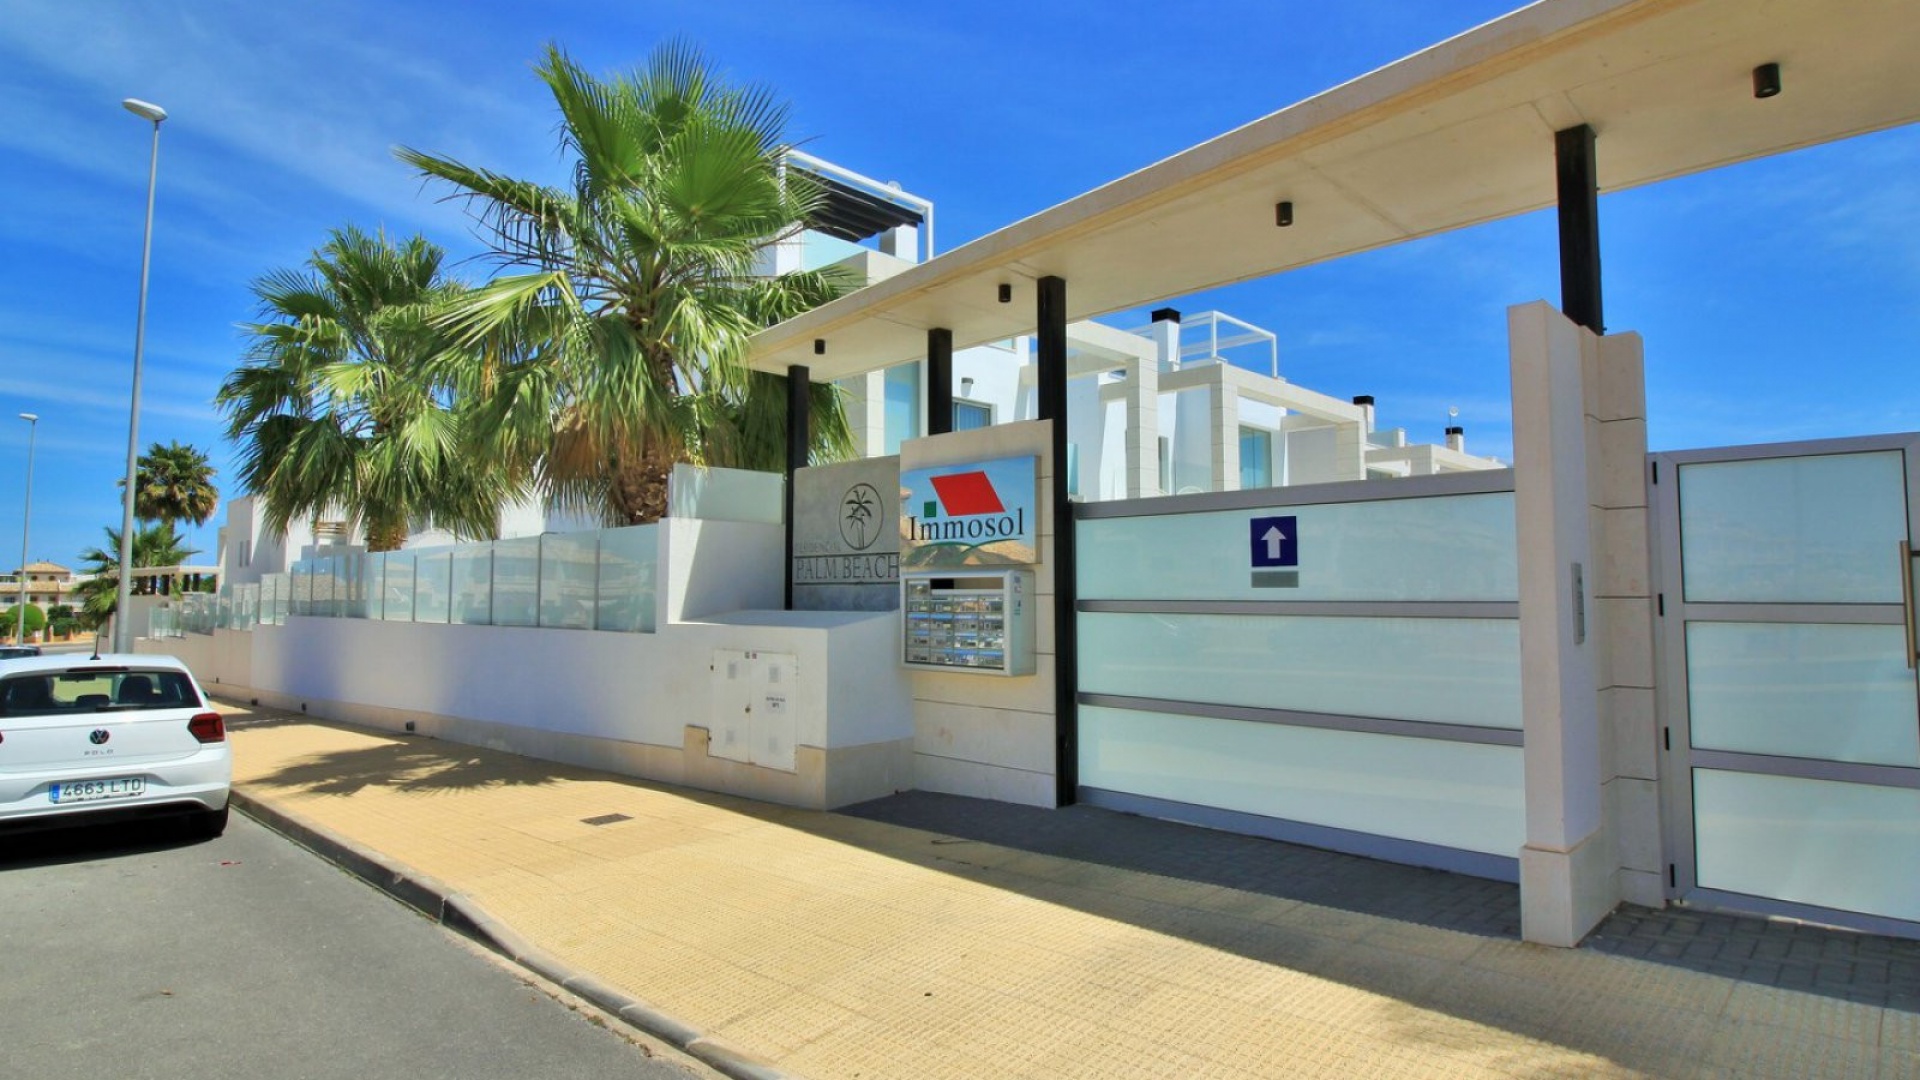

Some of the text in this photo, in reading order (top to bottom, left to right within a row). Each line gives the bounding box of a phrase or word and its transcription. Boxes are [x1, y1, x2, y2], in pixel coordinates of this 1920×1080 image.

[909, 507, 1024, 541] Immosol
[796, 555, 900, 580] PALM BEACH
[63, 782, 105, 797] 4663
